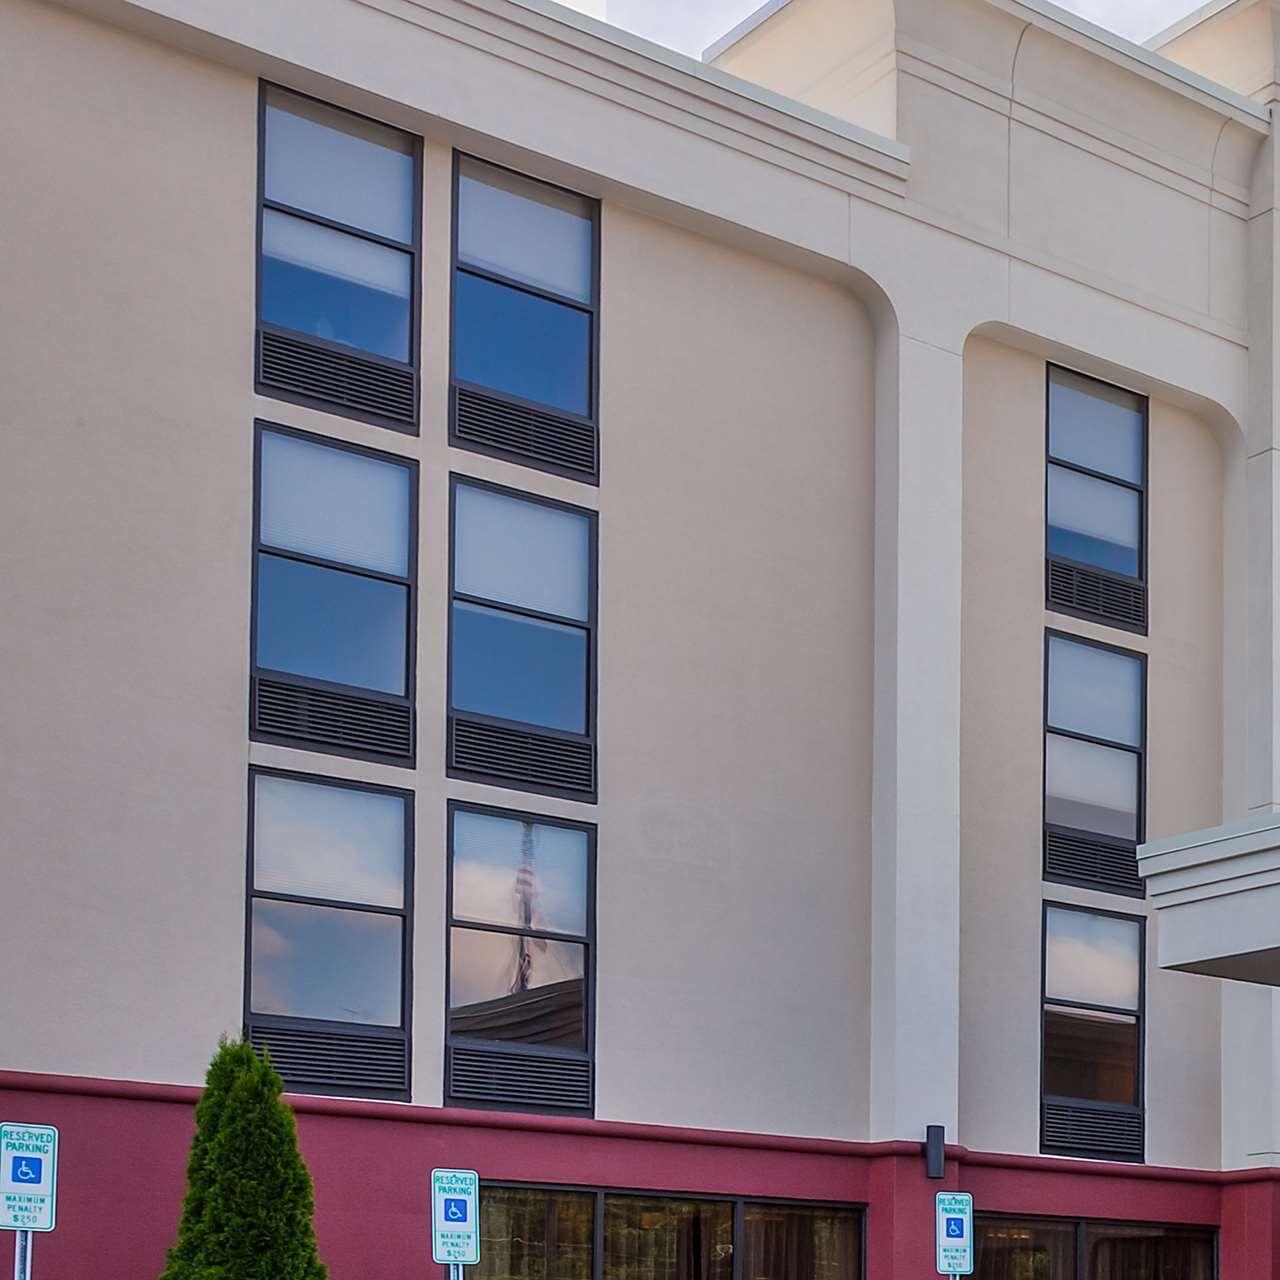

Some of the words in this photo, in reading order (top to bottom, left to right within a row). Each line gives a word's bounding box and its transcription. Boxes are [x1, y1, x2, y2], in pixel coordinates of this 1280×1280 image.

[2, 1129, 53, 1144] RESERVED
[6, 1141, 49, 1154] PARKING
[435, 1175, 474, 1185] RESERVED
[438, 1186, 472, 1195] PARKING
[5, 1195, 46, 1204] MAXIMUM
[7, 1204, 43, 1213] PENALTY
[942, 1207, 967, 1215] PARKING
[13, 1214, 38, 1223] $250
